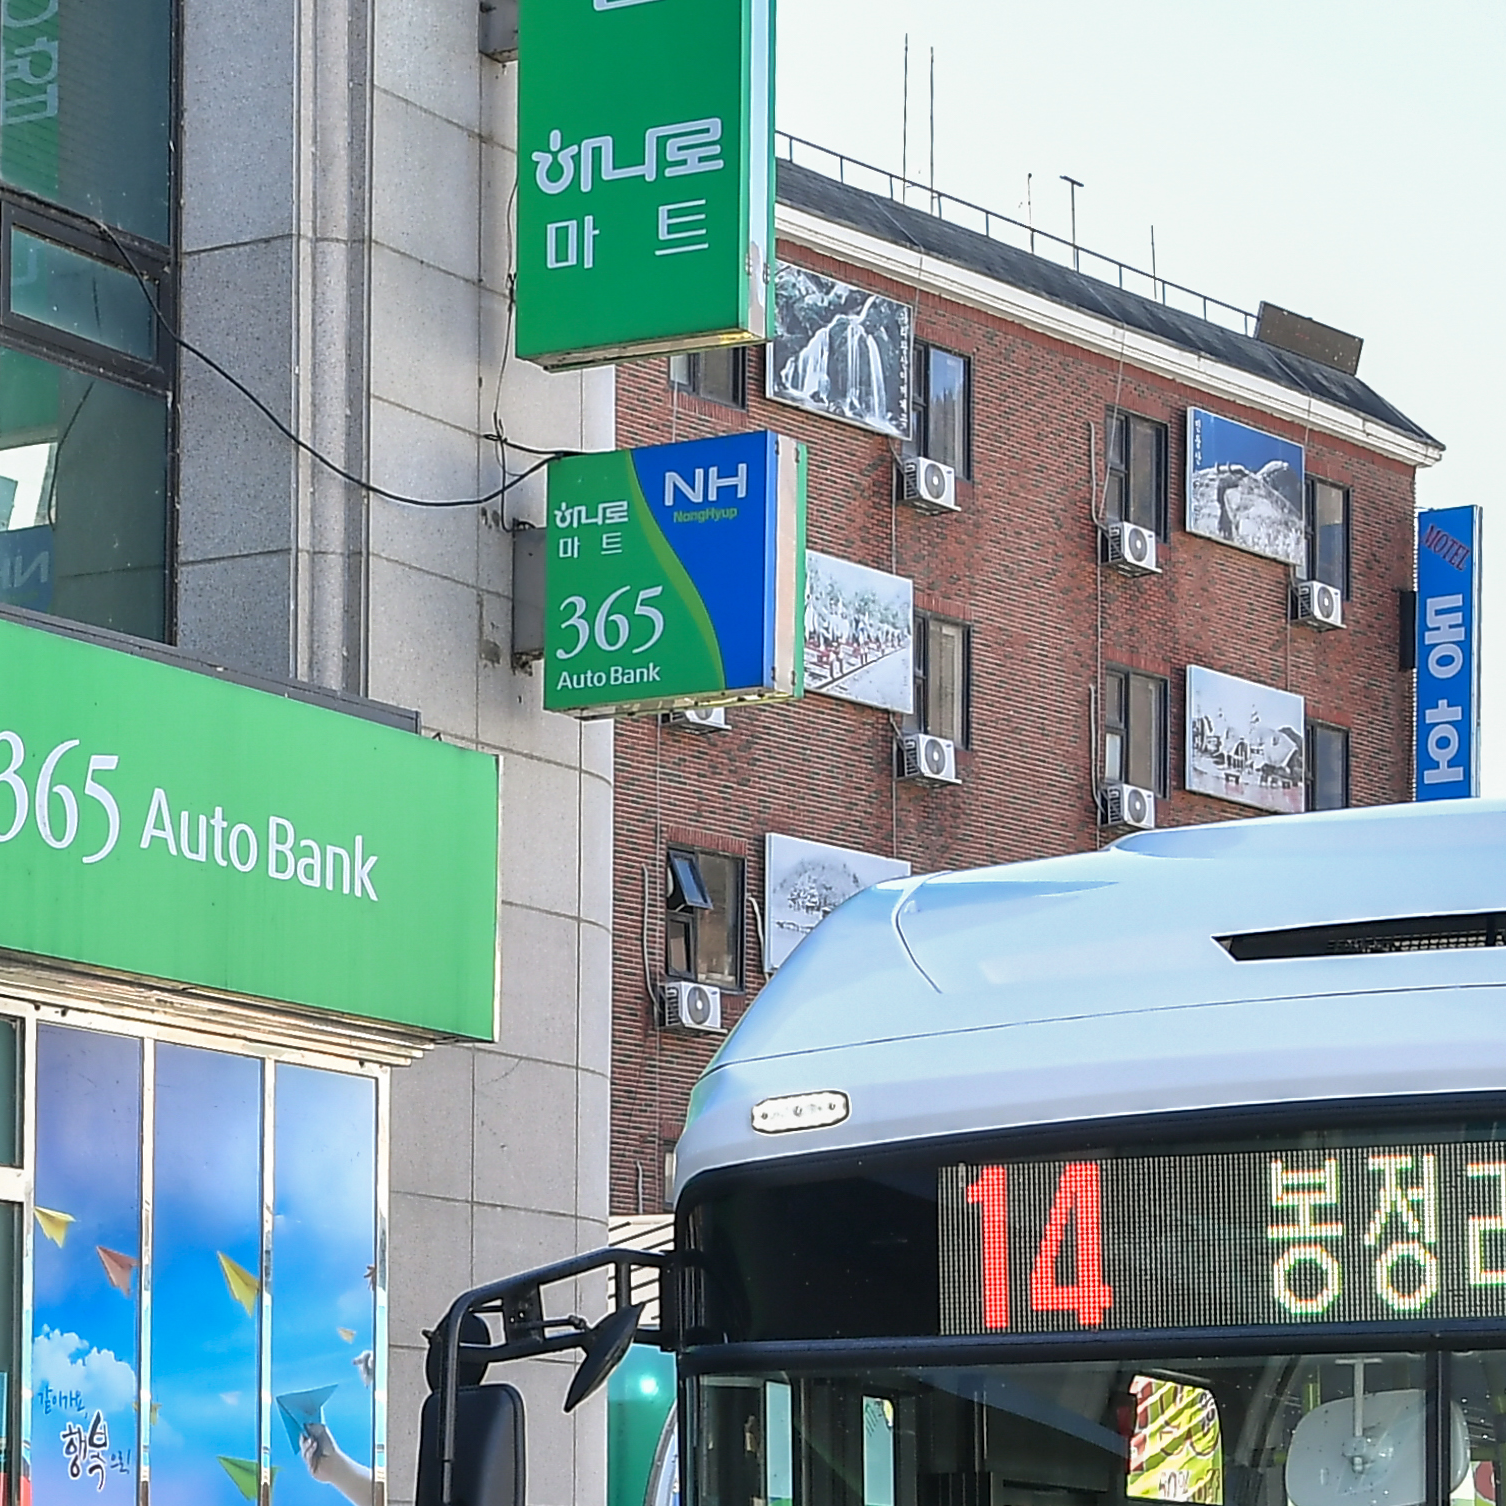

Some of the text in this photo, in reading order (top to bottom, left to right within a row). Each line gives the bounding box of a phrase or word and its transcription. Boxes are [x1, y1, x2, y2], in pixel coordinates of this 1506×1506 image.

[532, 117, 724, 194] 하나로
[554, 501, 628, 528] 하나로
[664, 463, 747, 506] NH
[673, 507, 738, 523] NongHyup
[1422, 523, 1471, 571] MOTEL
[555, 585, 665, 660] 365
[556, 662, 661, 690] Auto Bank
[1424, 594, 1465, 784] 동호
[140, 787, 258, 875] Auto
[268, 814, 380, 903] Bank
[965, 1161, 1113, 1329] 14
[60, 1409, 109, 1492] 행복
